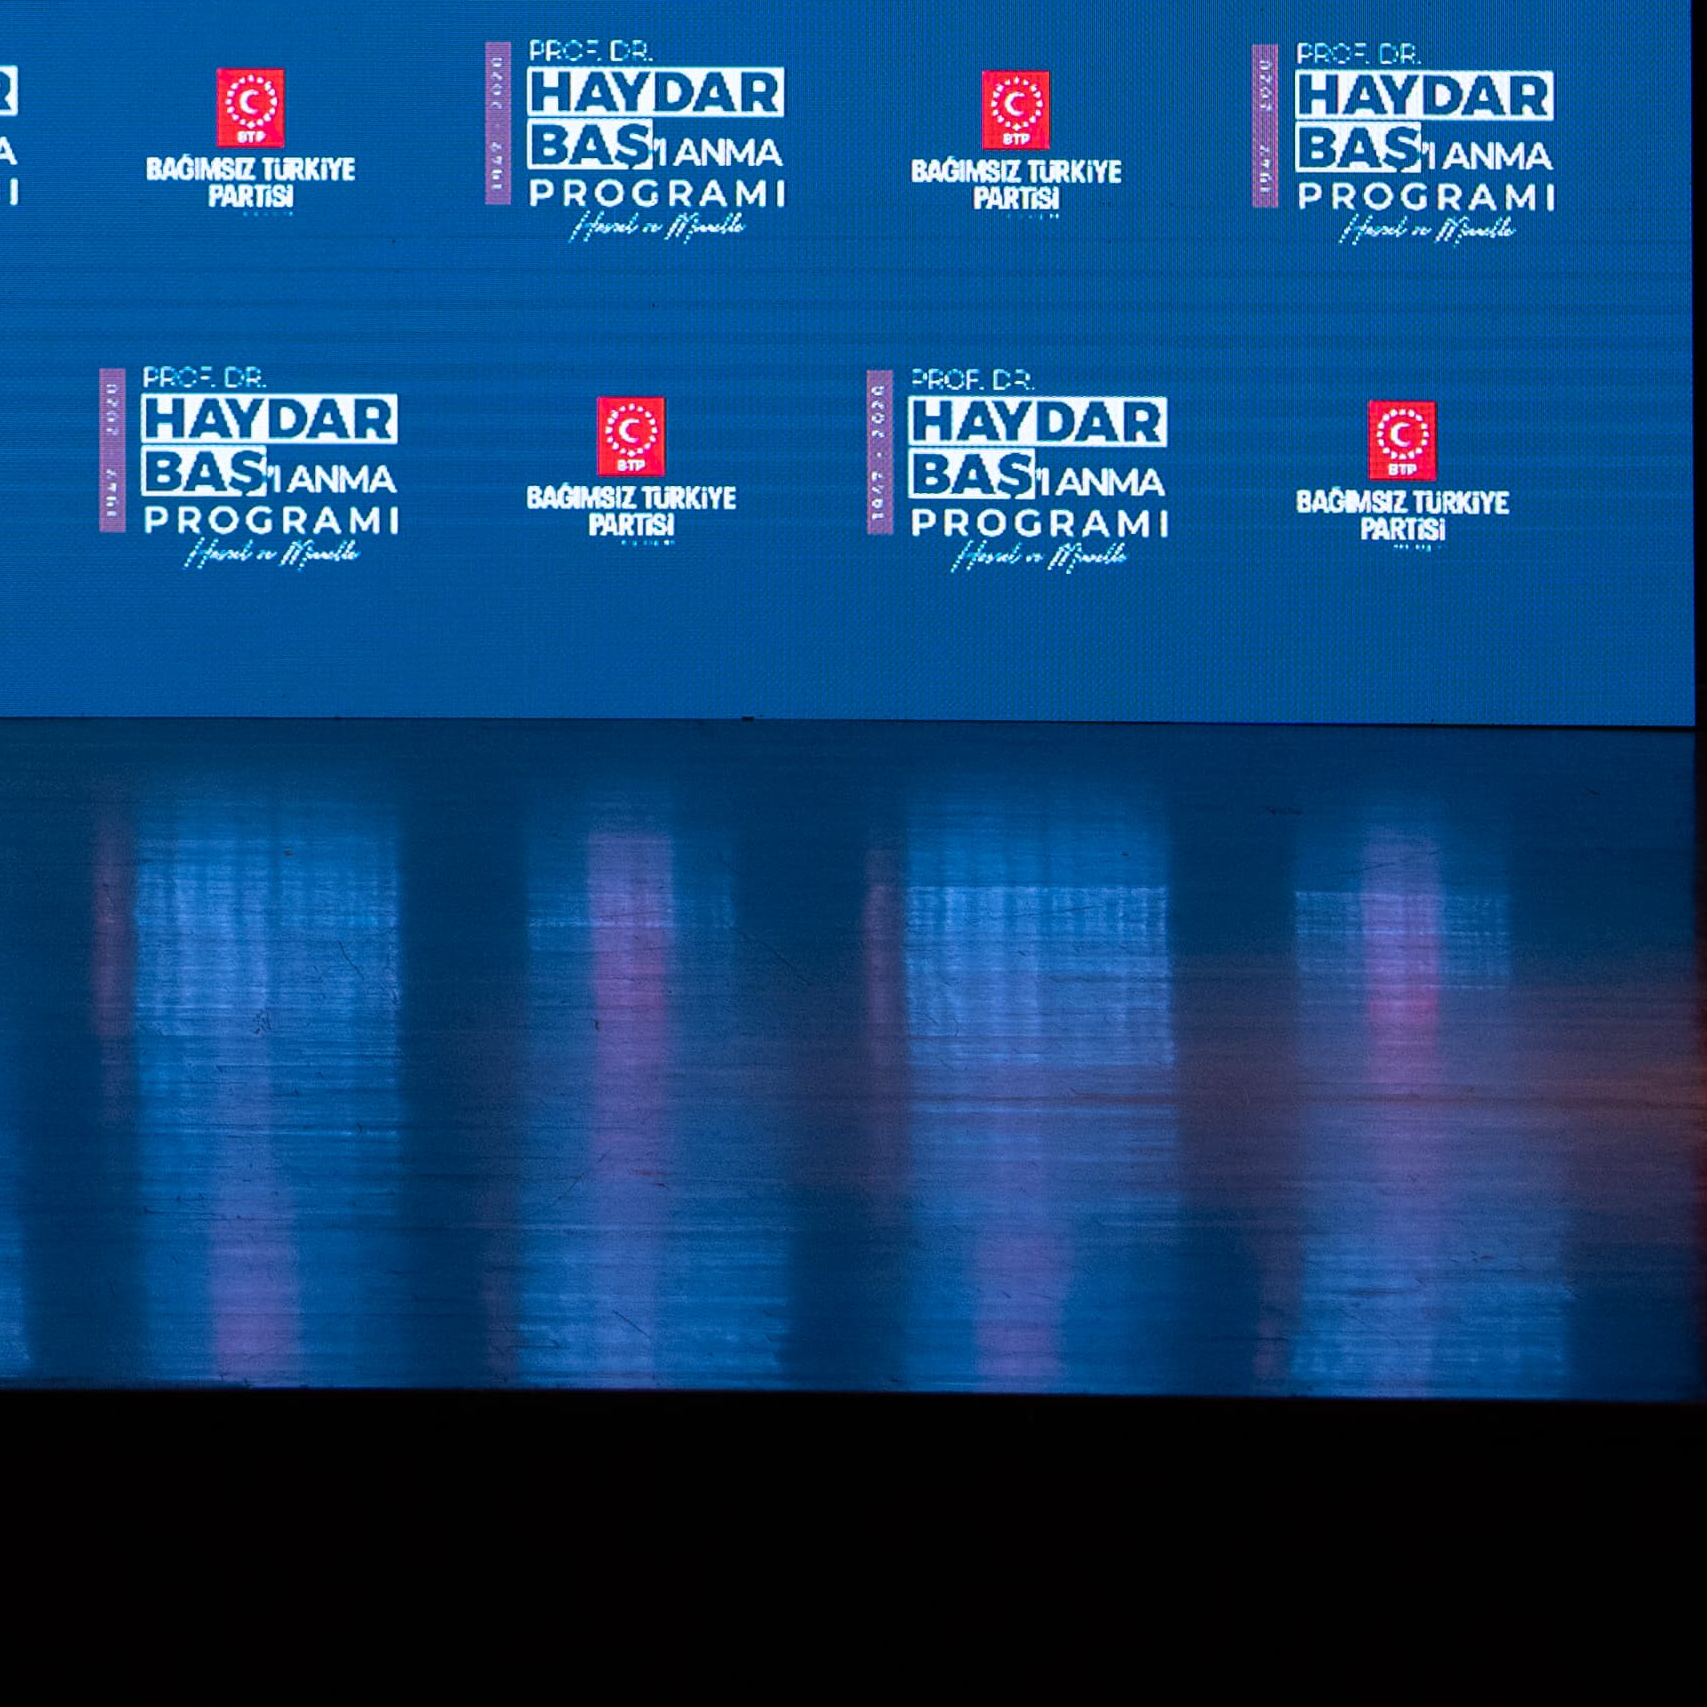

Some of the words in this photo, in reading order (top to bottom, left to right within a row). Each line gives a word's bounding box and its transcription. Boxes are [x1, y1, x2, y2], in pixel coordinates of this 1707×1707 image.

[533, 72, 778, 113] HAYDAR
[1301, 75, 1548, 116] HAYDAR
[674, 138, 782, 166] ANMA
[1443, 142, 1552, 170] ANMA
[530, 180, 784, 207] PROGRAMI
[1299, 183, 1554, 210] PROGRAMI
[147, 399, 392, 439] HAYDAR
[914, 401, 1161, 442] HAYDAR
[288, 465, 396, 492] ANMA
[1056, 468, 1165, 496] ANMA
[146, 506, 398, 534] PROGRAMI
[912, 509, 1167, 537] PROGRAMI
